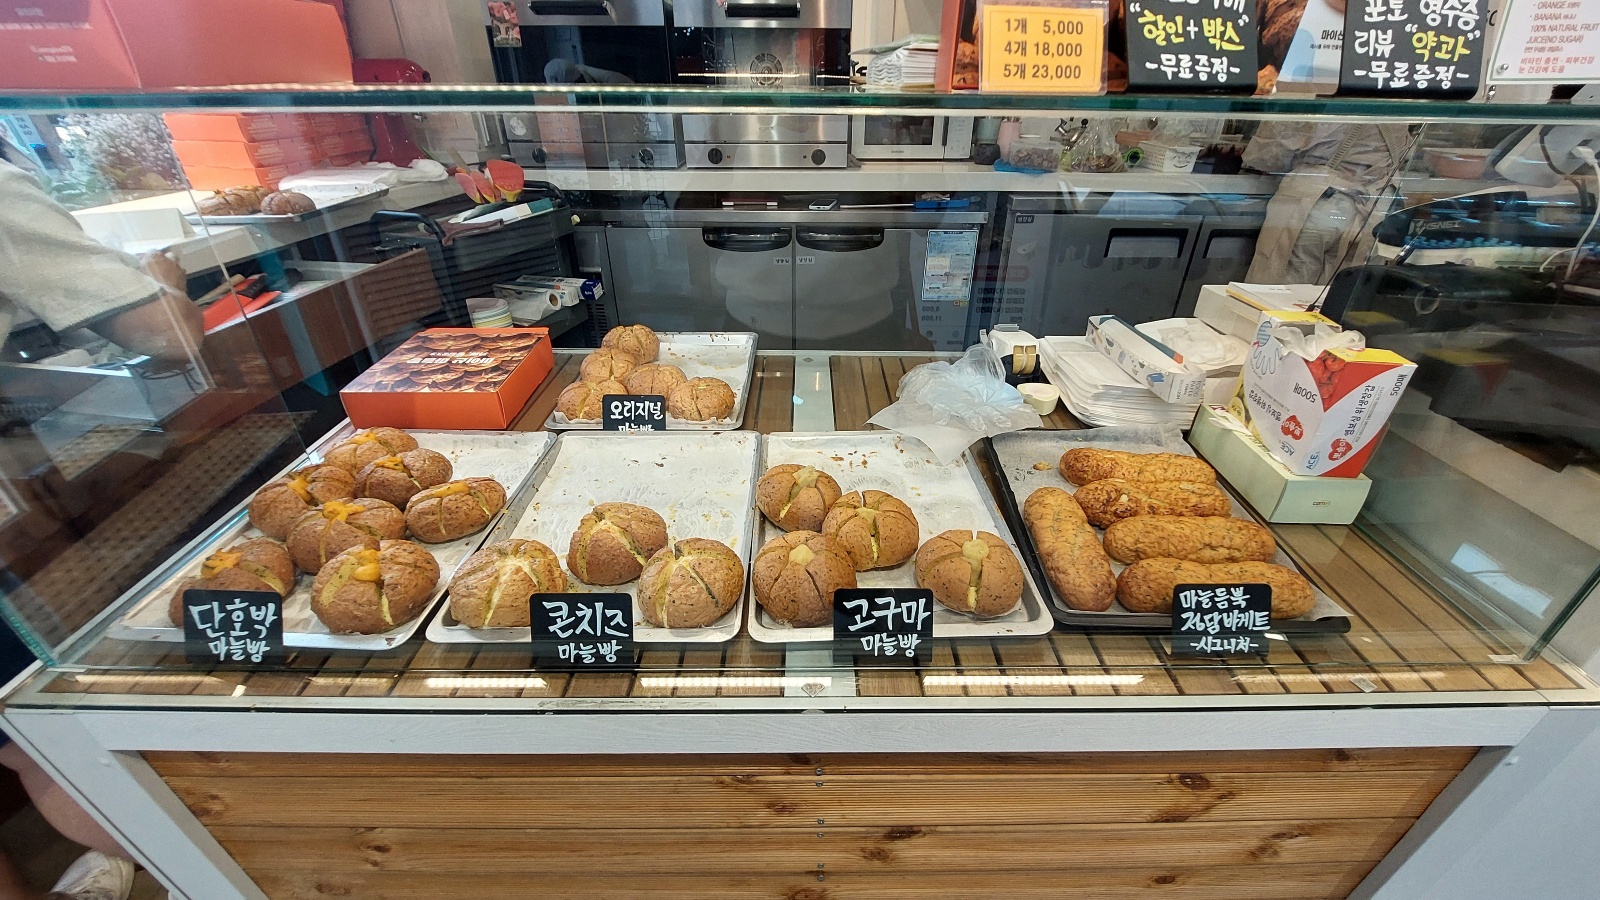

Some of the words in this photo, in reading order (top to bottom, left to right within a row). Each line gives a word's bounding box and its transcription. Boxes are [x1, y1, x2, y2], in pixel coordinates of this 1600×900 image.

[1364, 0, 1408, 22] 포토
[1420, 0, 1480, 31] 영수증
[1537, 1, 1567, 9] ORANGE
[1005, 18, 1027, 34] 1개
[1043, 20, 1084, 36] 5,000
[1531, 24, 1547, 32] 100%
[1548, 23, 1578, 32] NATURAL
[1580, 23, 1600, 31] FRUIT
[1534, 13, 1562, 21] BANANA
[1004, 40, 1027, 57] 4개
[1034, 41, 1083, 58] 18,000
[1354, 28, 1396, 58] 리뷰
[1003, 63, 1026, 80] 5개
[1031, 64, 1082, 81] 23,000
[1293, 382, 1318, 404] 500매
[1389, 373, 1408, 396] 500매
[610, 400, 664, 421] 오리지널
[1344, 415, 1362, 436] 엠보싱
[1354, 384, 1376, 416] 위생장갑
[1280, 441, 1295, 457] ACE
[1306, 454, 1319, 470] ACE
[188, 598, 279, 639] 단호박
[541, 601, 630, 639] 콘치즈
[842, 596, 931, 632] 고구마
[208, 636, 271, 663] 마늘빵
[557, 639, 623, 663] 마늘빵
[860, 632, 922, 658] 마늘빵
